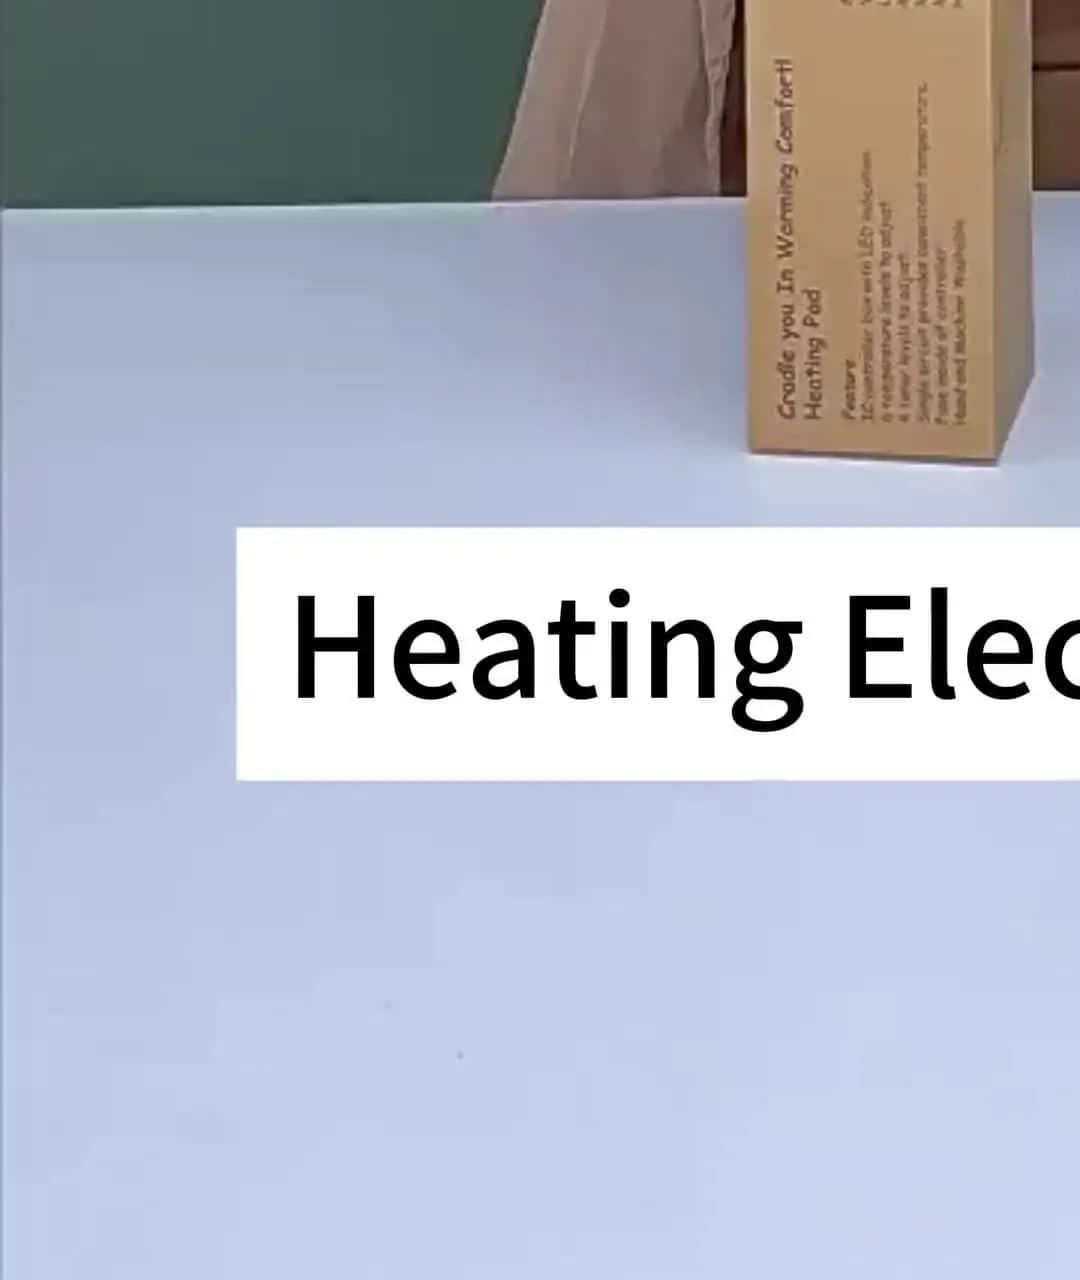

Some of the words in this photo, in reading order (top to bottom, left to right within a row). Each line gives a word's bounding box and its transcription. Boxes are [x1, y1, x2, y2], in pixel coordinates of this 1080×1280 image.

[772, 58, 795, 154] Comfort!
[776, 164, 798, 258] Warming
[878, 201, 895, 248] adjust
[858, 225, 874, 257] LED
[880, 250, 892, 267] to
[776, 270, 794, 294] In
[879, 272, 892, 314] levels
[896, 254, 914, 301] adjust
[934, 248, 947, 320] controller
[780, 304, 800, 342] you
[800, 288, 822, 328] Pad
[898, 304, 910, 320] to
[952, 295, 966, 354] Machine
[933, 325, 948, 342] of
[776, 352, 795, 419] Cradle
[802, 337, 828, 420] Heating
[880, 319, 894, 408] temperature
[841, 360, 856, 420] Feature
